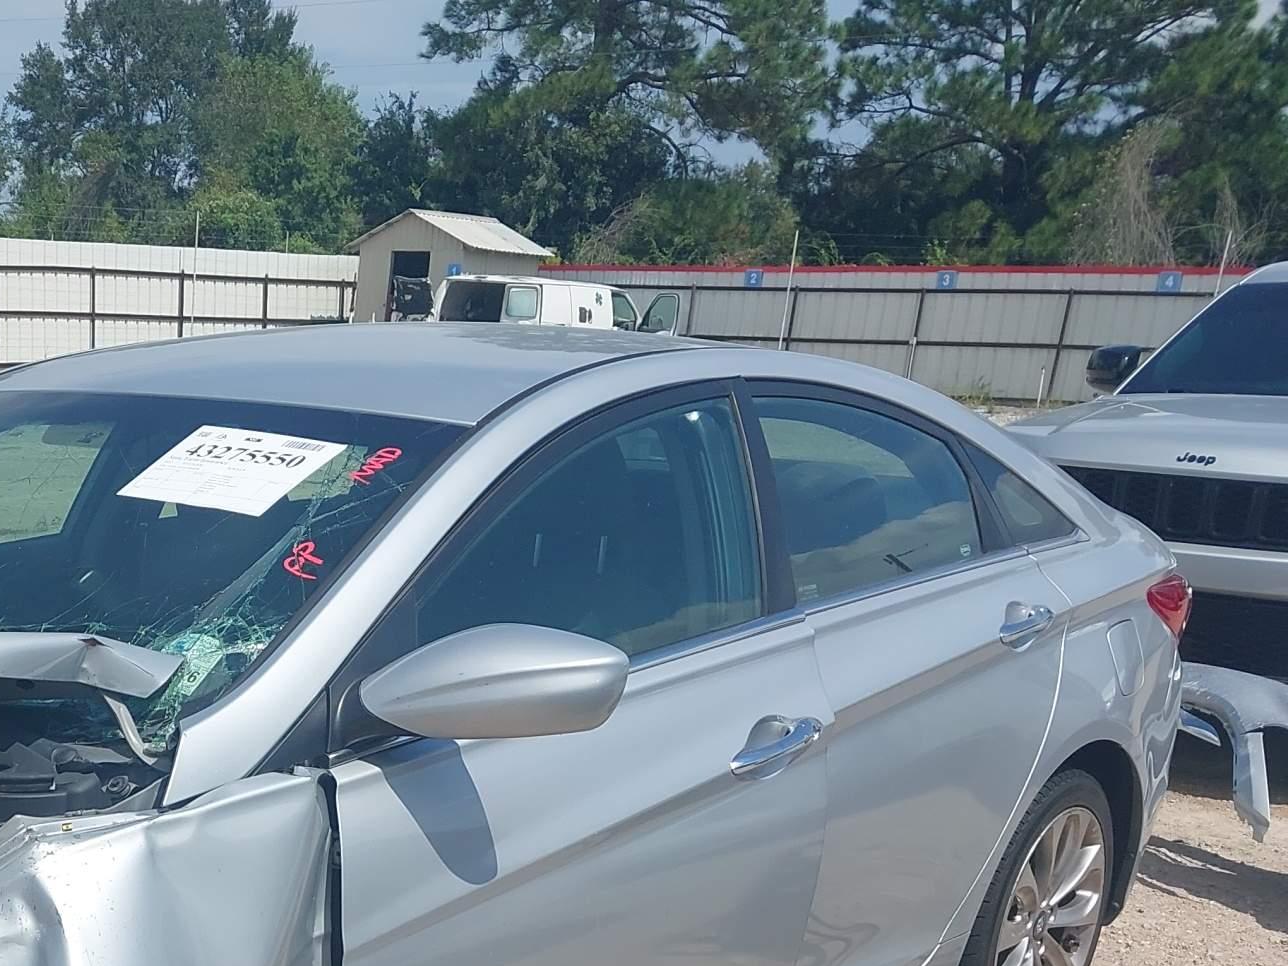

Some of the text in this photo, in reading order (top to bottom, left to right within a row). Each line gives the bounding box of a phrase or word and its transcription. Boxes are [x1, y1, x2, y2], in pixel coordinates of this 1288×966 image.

[750, 272, 758, 284] 2
[942, 274, 951, 286] 3
[1165, 275, 1174, 288] 4
[185, 443, 307, 468] 43275550
[1176, 452, 1217, 466] Jeep
